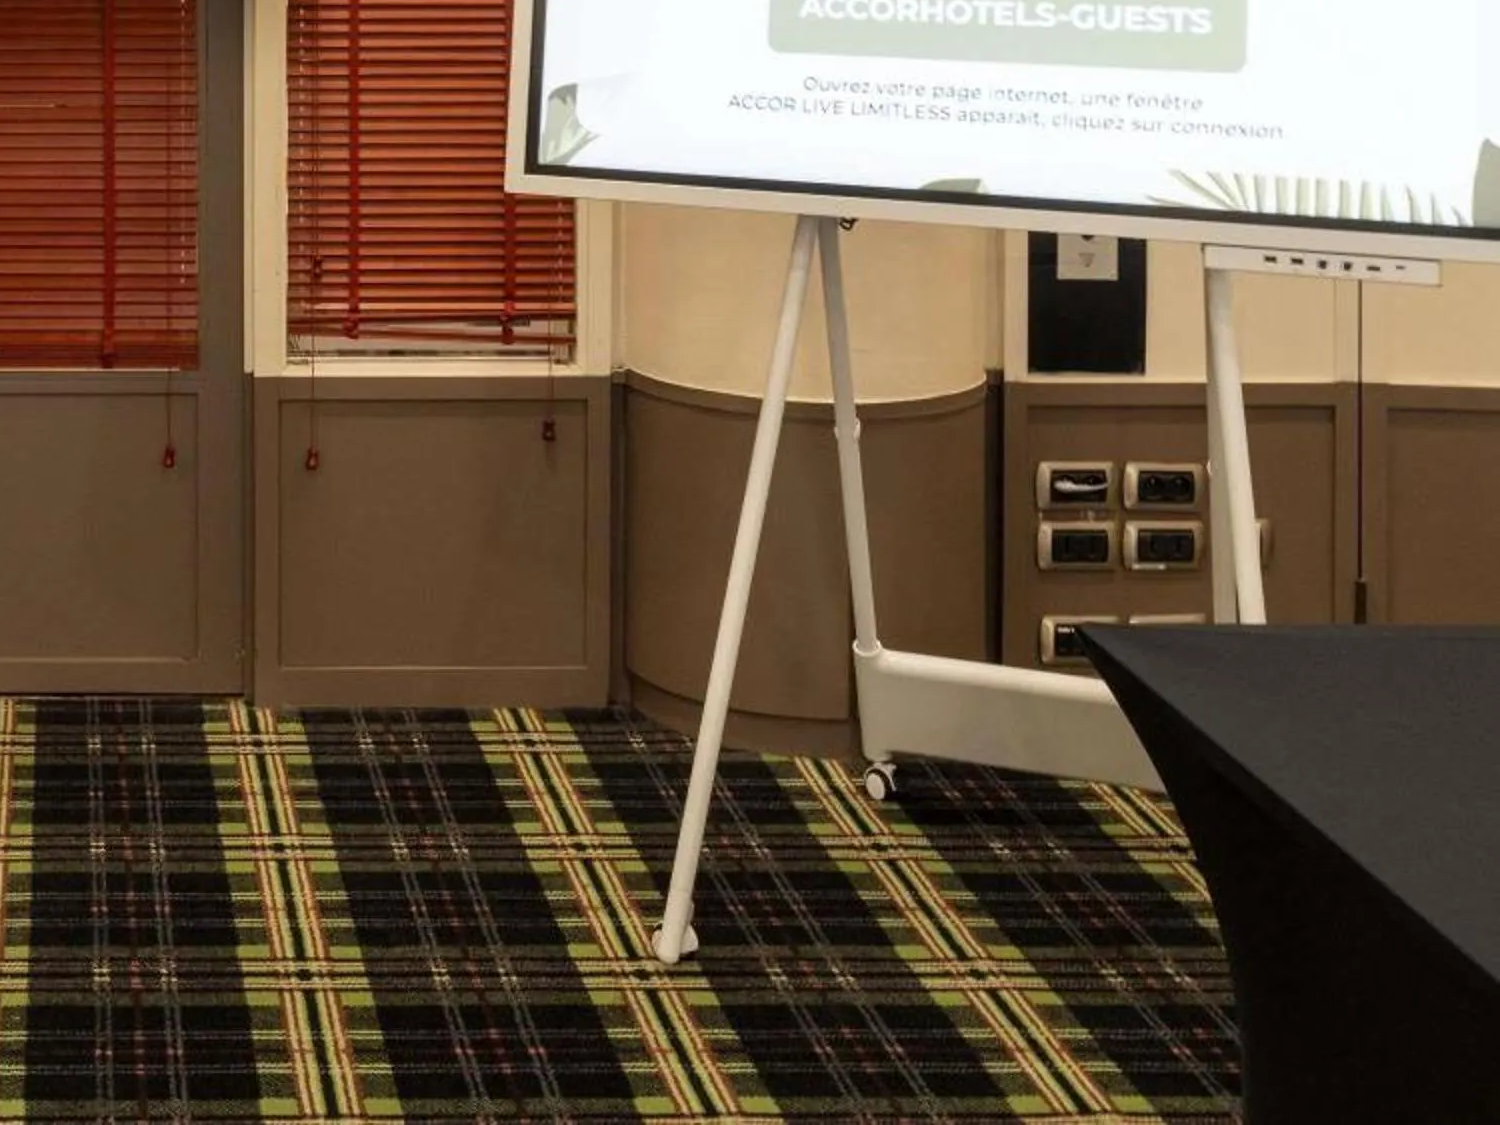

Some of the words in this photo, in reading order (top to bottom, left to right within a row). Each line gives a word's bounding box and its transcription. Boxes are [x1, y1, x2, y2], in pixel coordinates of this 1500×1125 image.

[803, 75, 871, 94] Ouvrez
[875, 81, 926, 98] votre
[932, 84, 983, 104] page
[1080, 92, 1121, 107] une
[728, 93, 797, 112] ACCOR
[802, 97, 846, 115] LIVE
[850, 99, 951, 121] LIMITLESS
[1051, 110, 1125, 132] cliquez
[1131, 118, 1164, 133] sur
[1170, 118, 1284, 139] connexion
